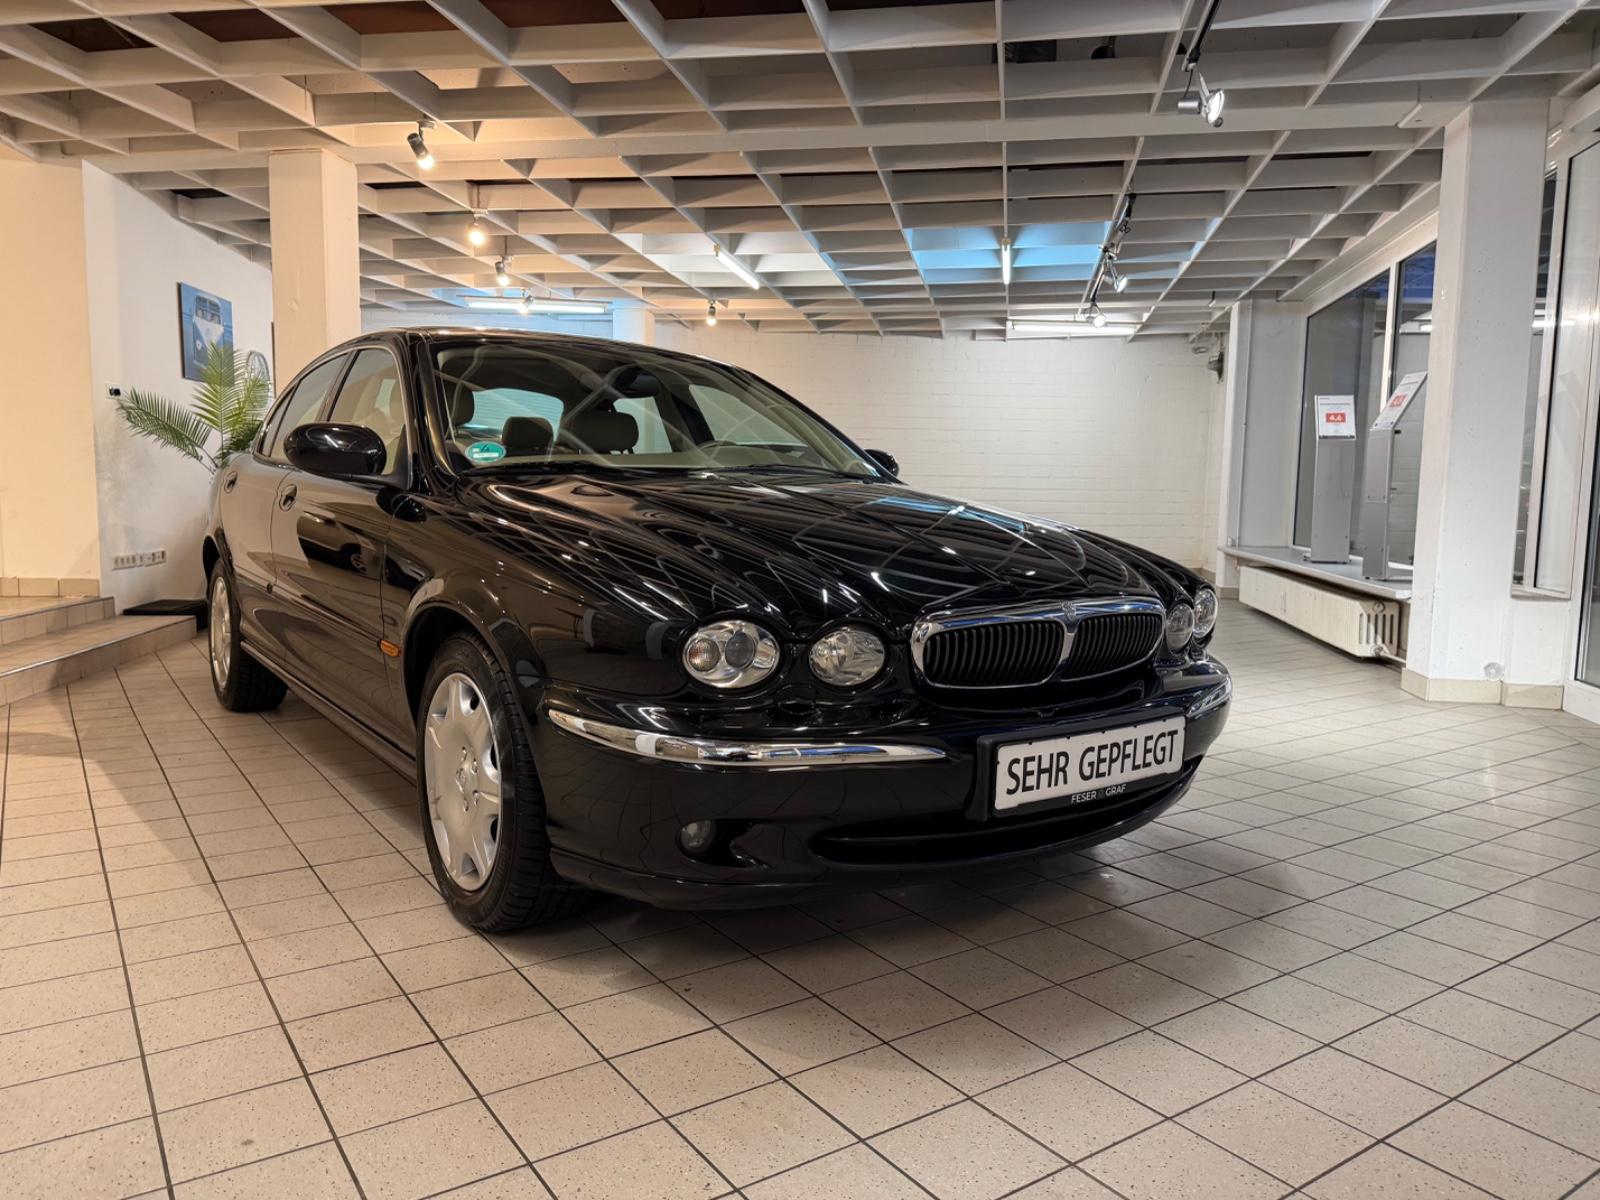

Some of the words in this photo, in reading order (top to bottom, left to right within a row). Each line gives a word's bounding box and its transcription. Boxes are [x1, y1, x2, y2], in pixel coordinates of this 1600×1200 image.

[1006, 751, 1070, 795] SEHR
[1078, 730, 1178, 781] GEPFLEGT
[1071, 790, 1097, 804] FESER
[1105, 783, 1127, 797] GRAF
